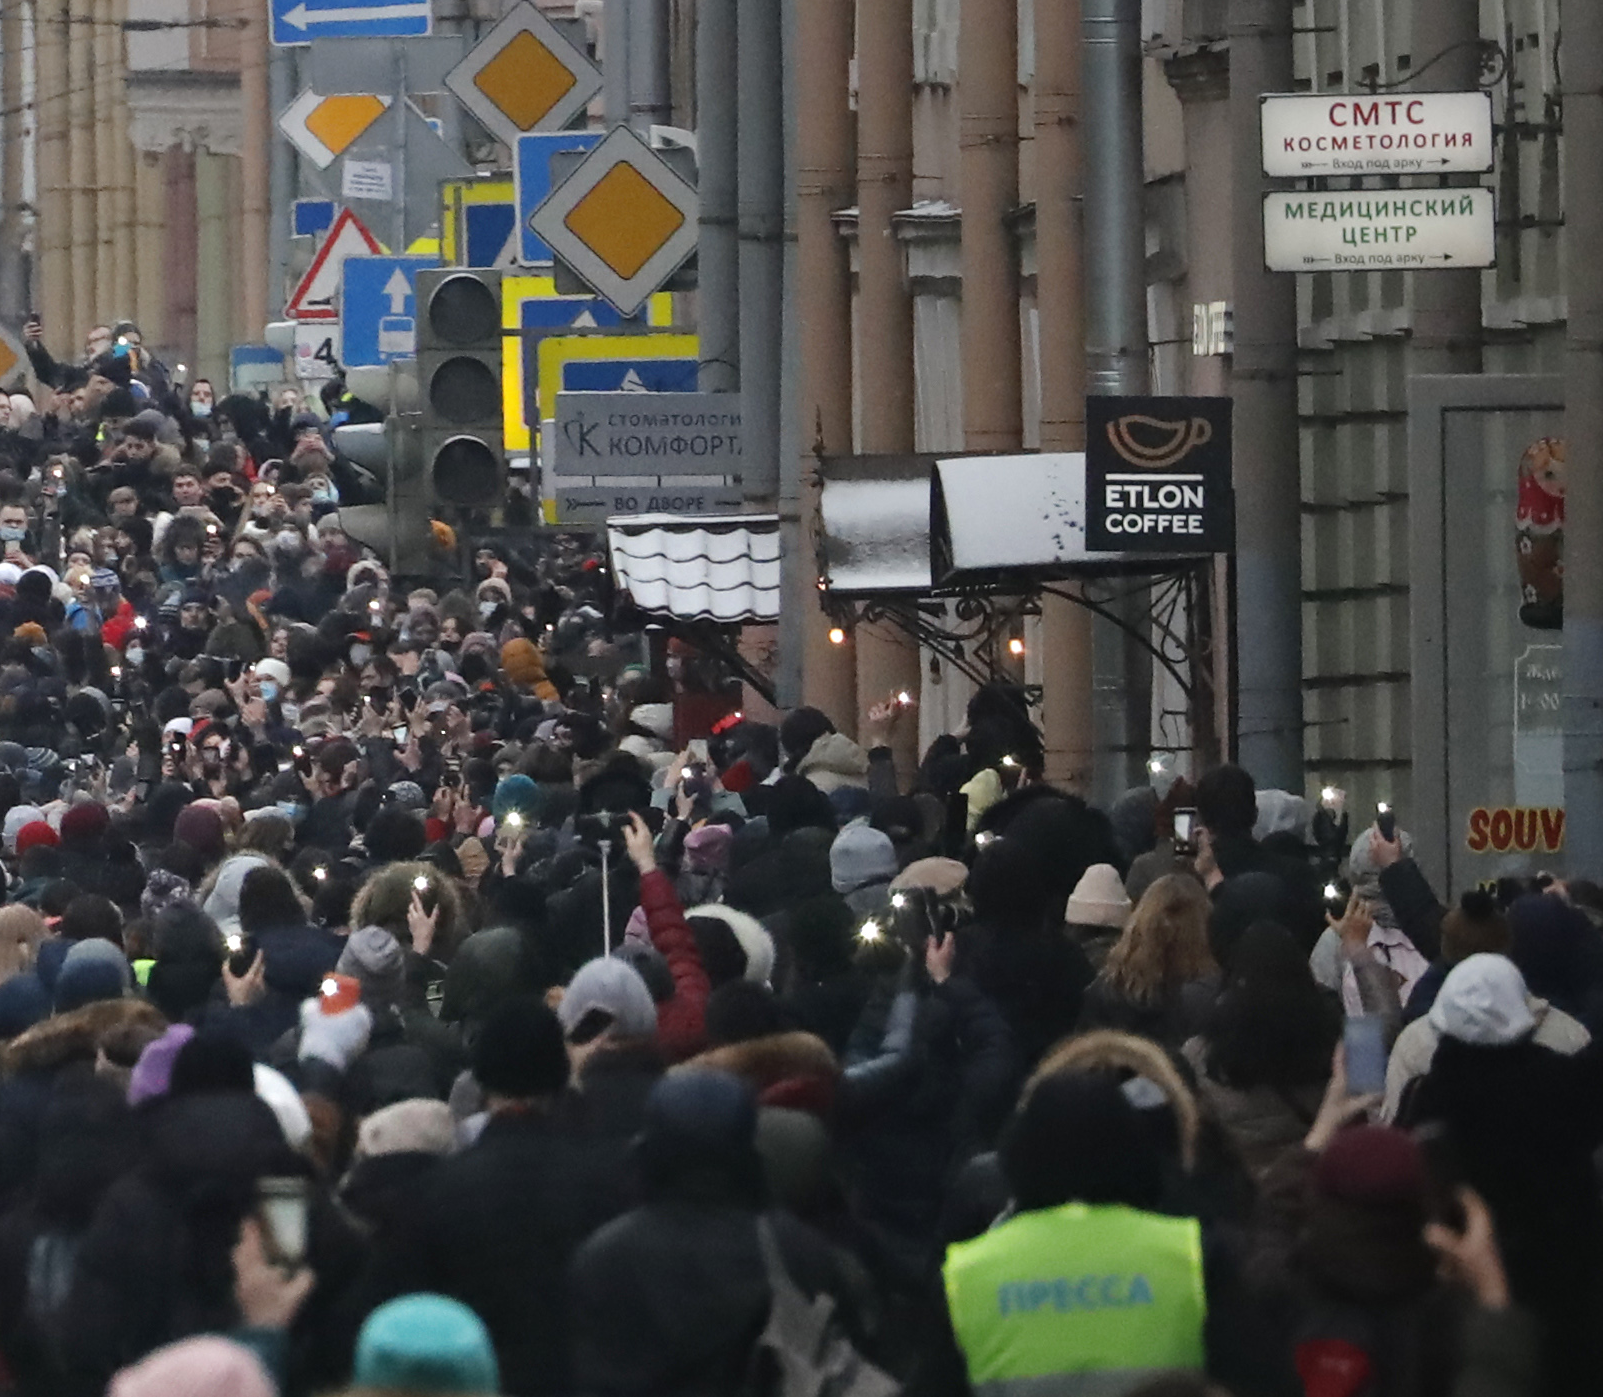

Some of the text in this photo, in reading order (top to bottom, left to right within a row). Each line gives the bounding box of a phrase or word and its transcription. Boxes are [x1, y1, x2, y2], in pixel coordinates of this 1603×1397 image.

[1328, 100, 1424, 127] СМТС
[1283, 133, 1473, 152] КОСМЕТОЛОГИЯ
[1332, 158, 1423, 170] Вход под арку
[1285, 195, 1474, 222] МЕДИЦИНСКИЙ
[1342, 226, 1417, 247] ЦЕНТР
[1335, 253, 1425, 265] Вход под арку
[609, 435, 743, 456] КОМФОРТ
[614, 497, 705, 512] ВО ДВОРЕ
[1105, 485, 1204, 509] ETLON
[1105, 514, 1204, 534] COFFEE
[1467, 807, 1566, 853] SOUV
[998, 1273, 1155, 1319] ПРЕССА
